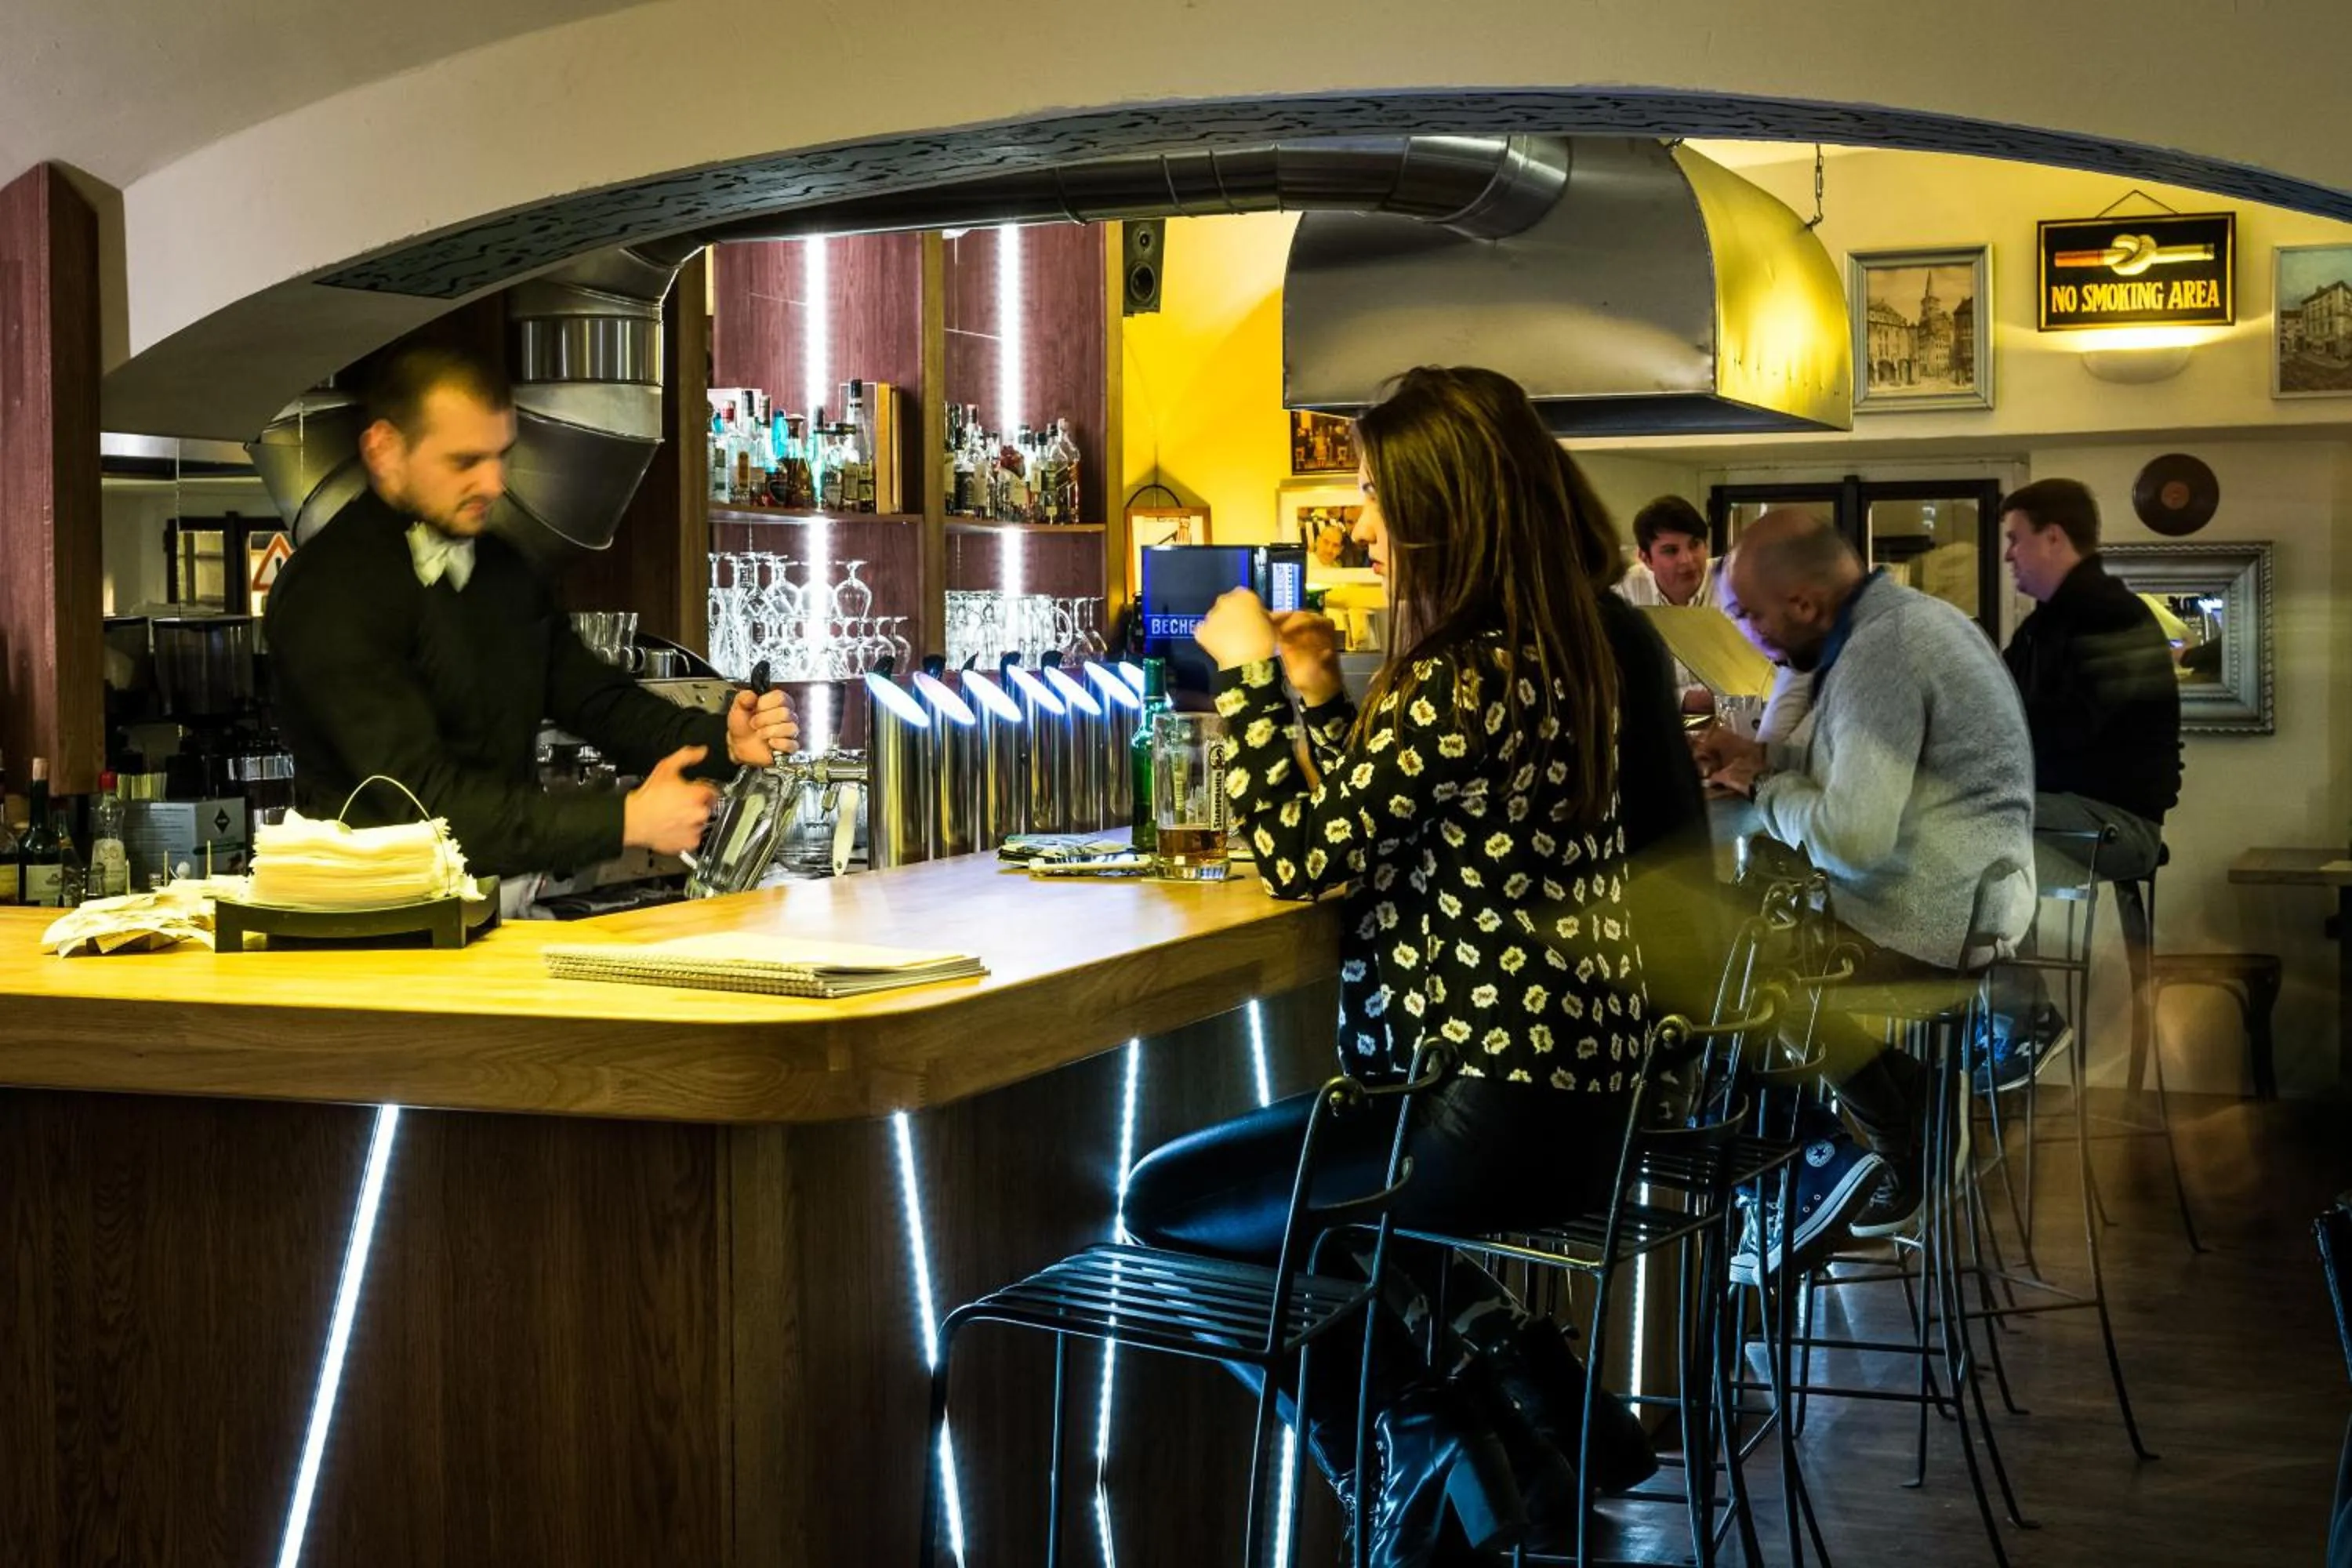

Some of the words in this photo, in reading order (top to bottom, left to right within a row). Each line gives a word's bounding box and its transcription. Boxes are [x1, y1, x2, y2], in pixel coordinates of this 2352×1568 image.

[2052, 285, 2077, 313] NO
[2082, 281, 2164, 312] SMOKING
[2167, 279, 2220, 310] AREA
[1152, 619, 1200, 634] BECHE
